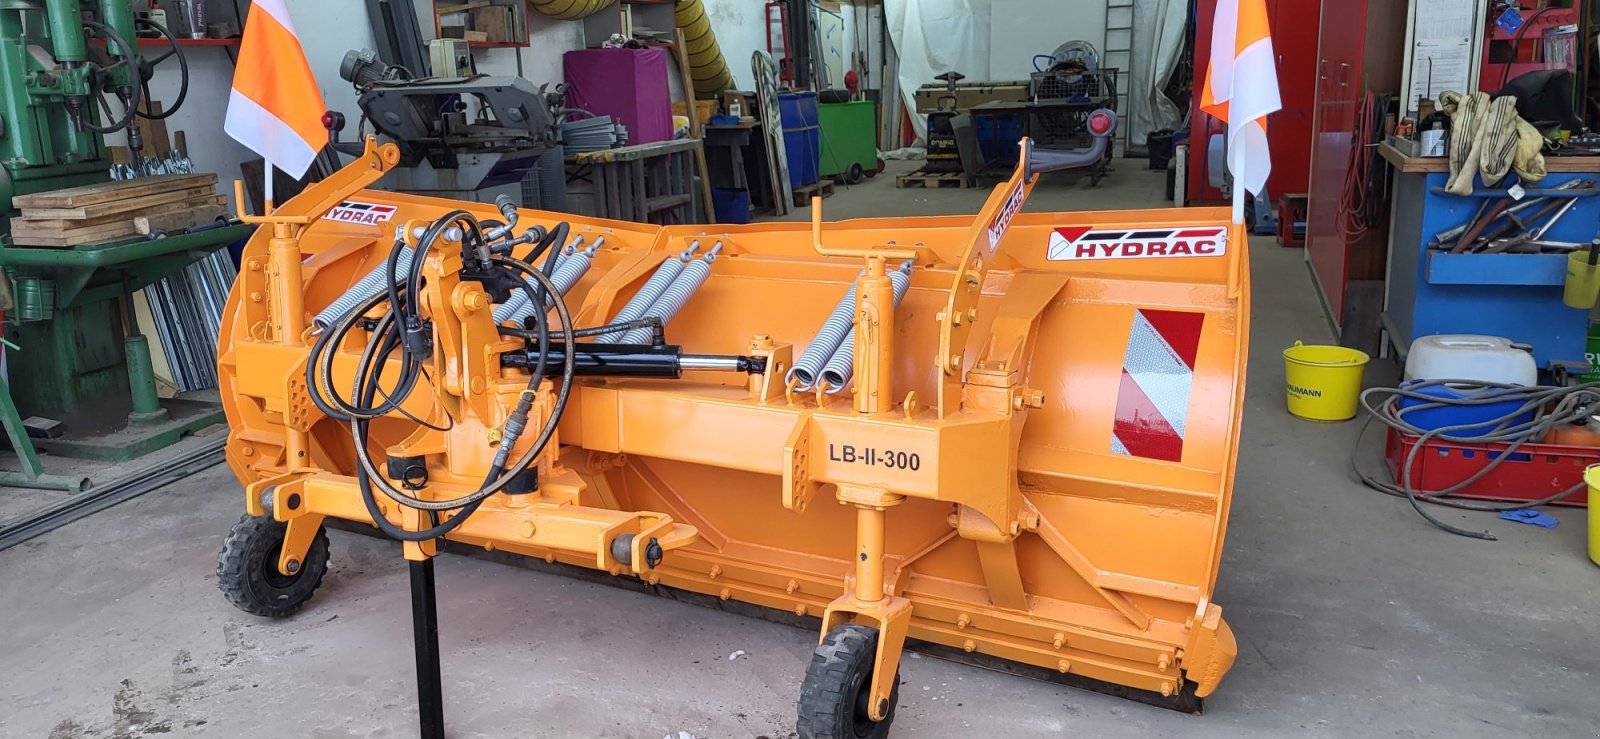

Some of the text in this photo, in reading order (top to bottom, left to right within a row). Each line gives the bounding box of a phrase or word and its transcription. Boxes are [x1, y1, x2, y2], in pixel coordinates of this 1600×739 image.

[996, 190, 1022, 240] HYDRAC
[1075, 240, 1216, 258] HYDRAC
[829, 443, 920, 471] LB-II-300
